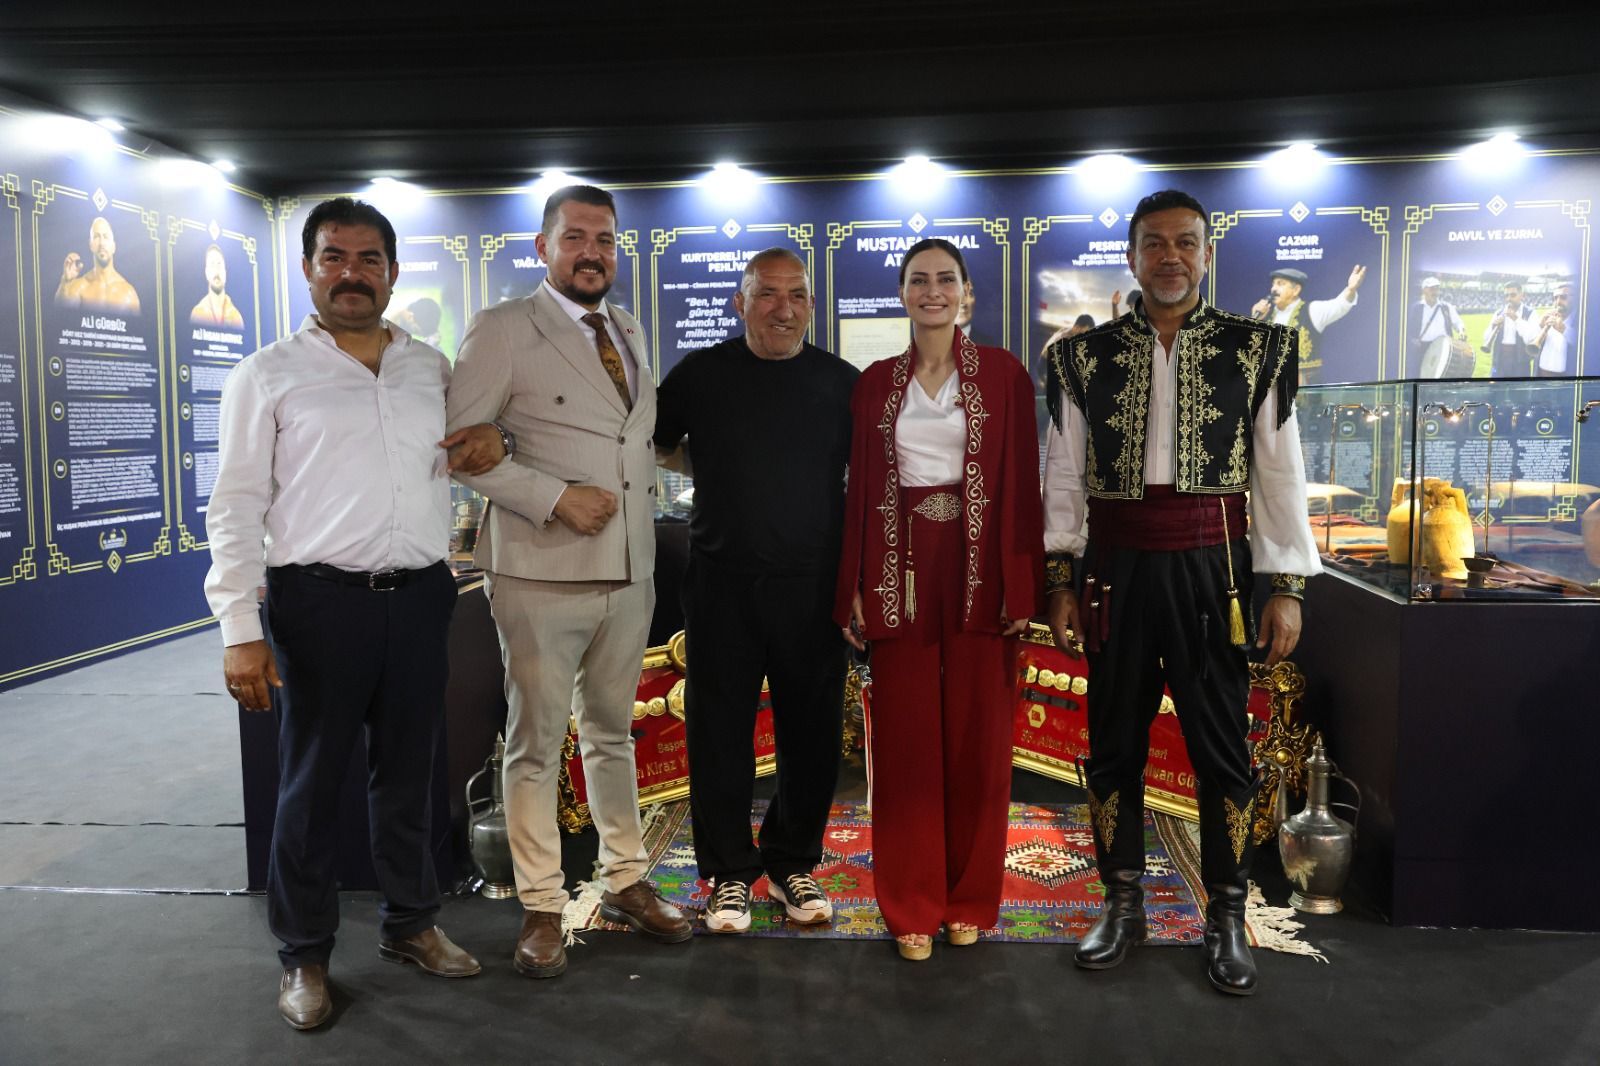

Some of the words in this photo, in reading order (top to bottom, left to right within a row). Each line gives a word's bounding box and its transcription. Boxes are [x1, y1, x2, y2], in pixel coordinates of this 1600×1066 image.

[1448, 230, 1485, 241] DAVUL
[1487, 230, 1502, 240] VE
[1504, 228, 1543, 240] ZURNA
[1278, 235, 1319, 246] CAZGIR
[681, 250, 741, 263] KURTDERELİ
[512, 256, 547, 269] YAĞLA
[708, 260, 747, 272] PEHLİVA
[712, 296, 728, 306] her
[688, 308, 724, 319] güreşte
[81, 315, 95, 329] ALİ
[95, 317, 127, 332] GÜRBÜZ
[676, 319, 716, 328] arkamda
[717, 317, 738, 327] Türk
[685, 328, 728, 338] milletinin
[677, 339, 724, 349] bulundu
